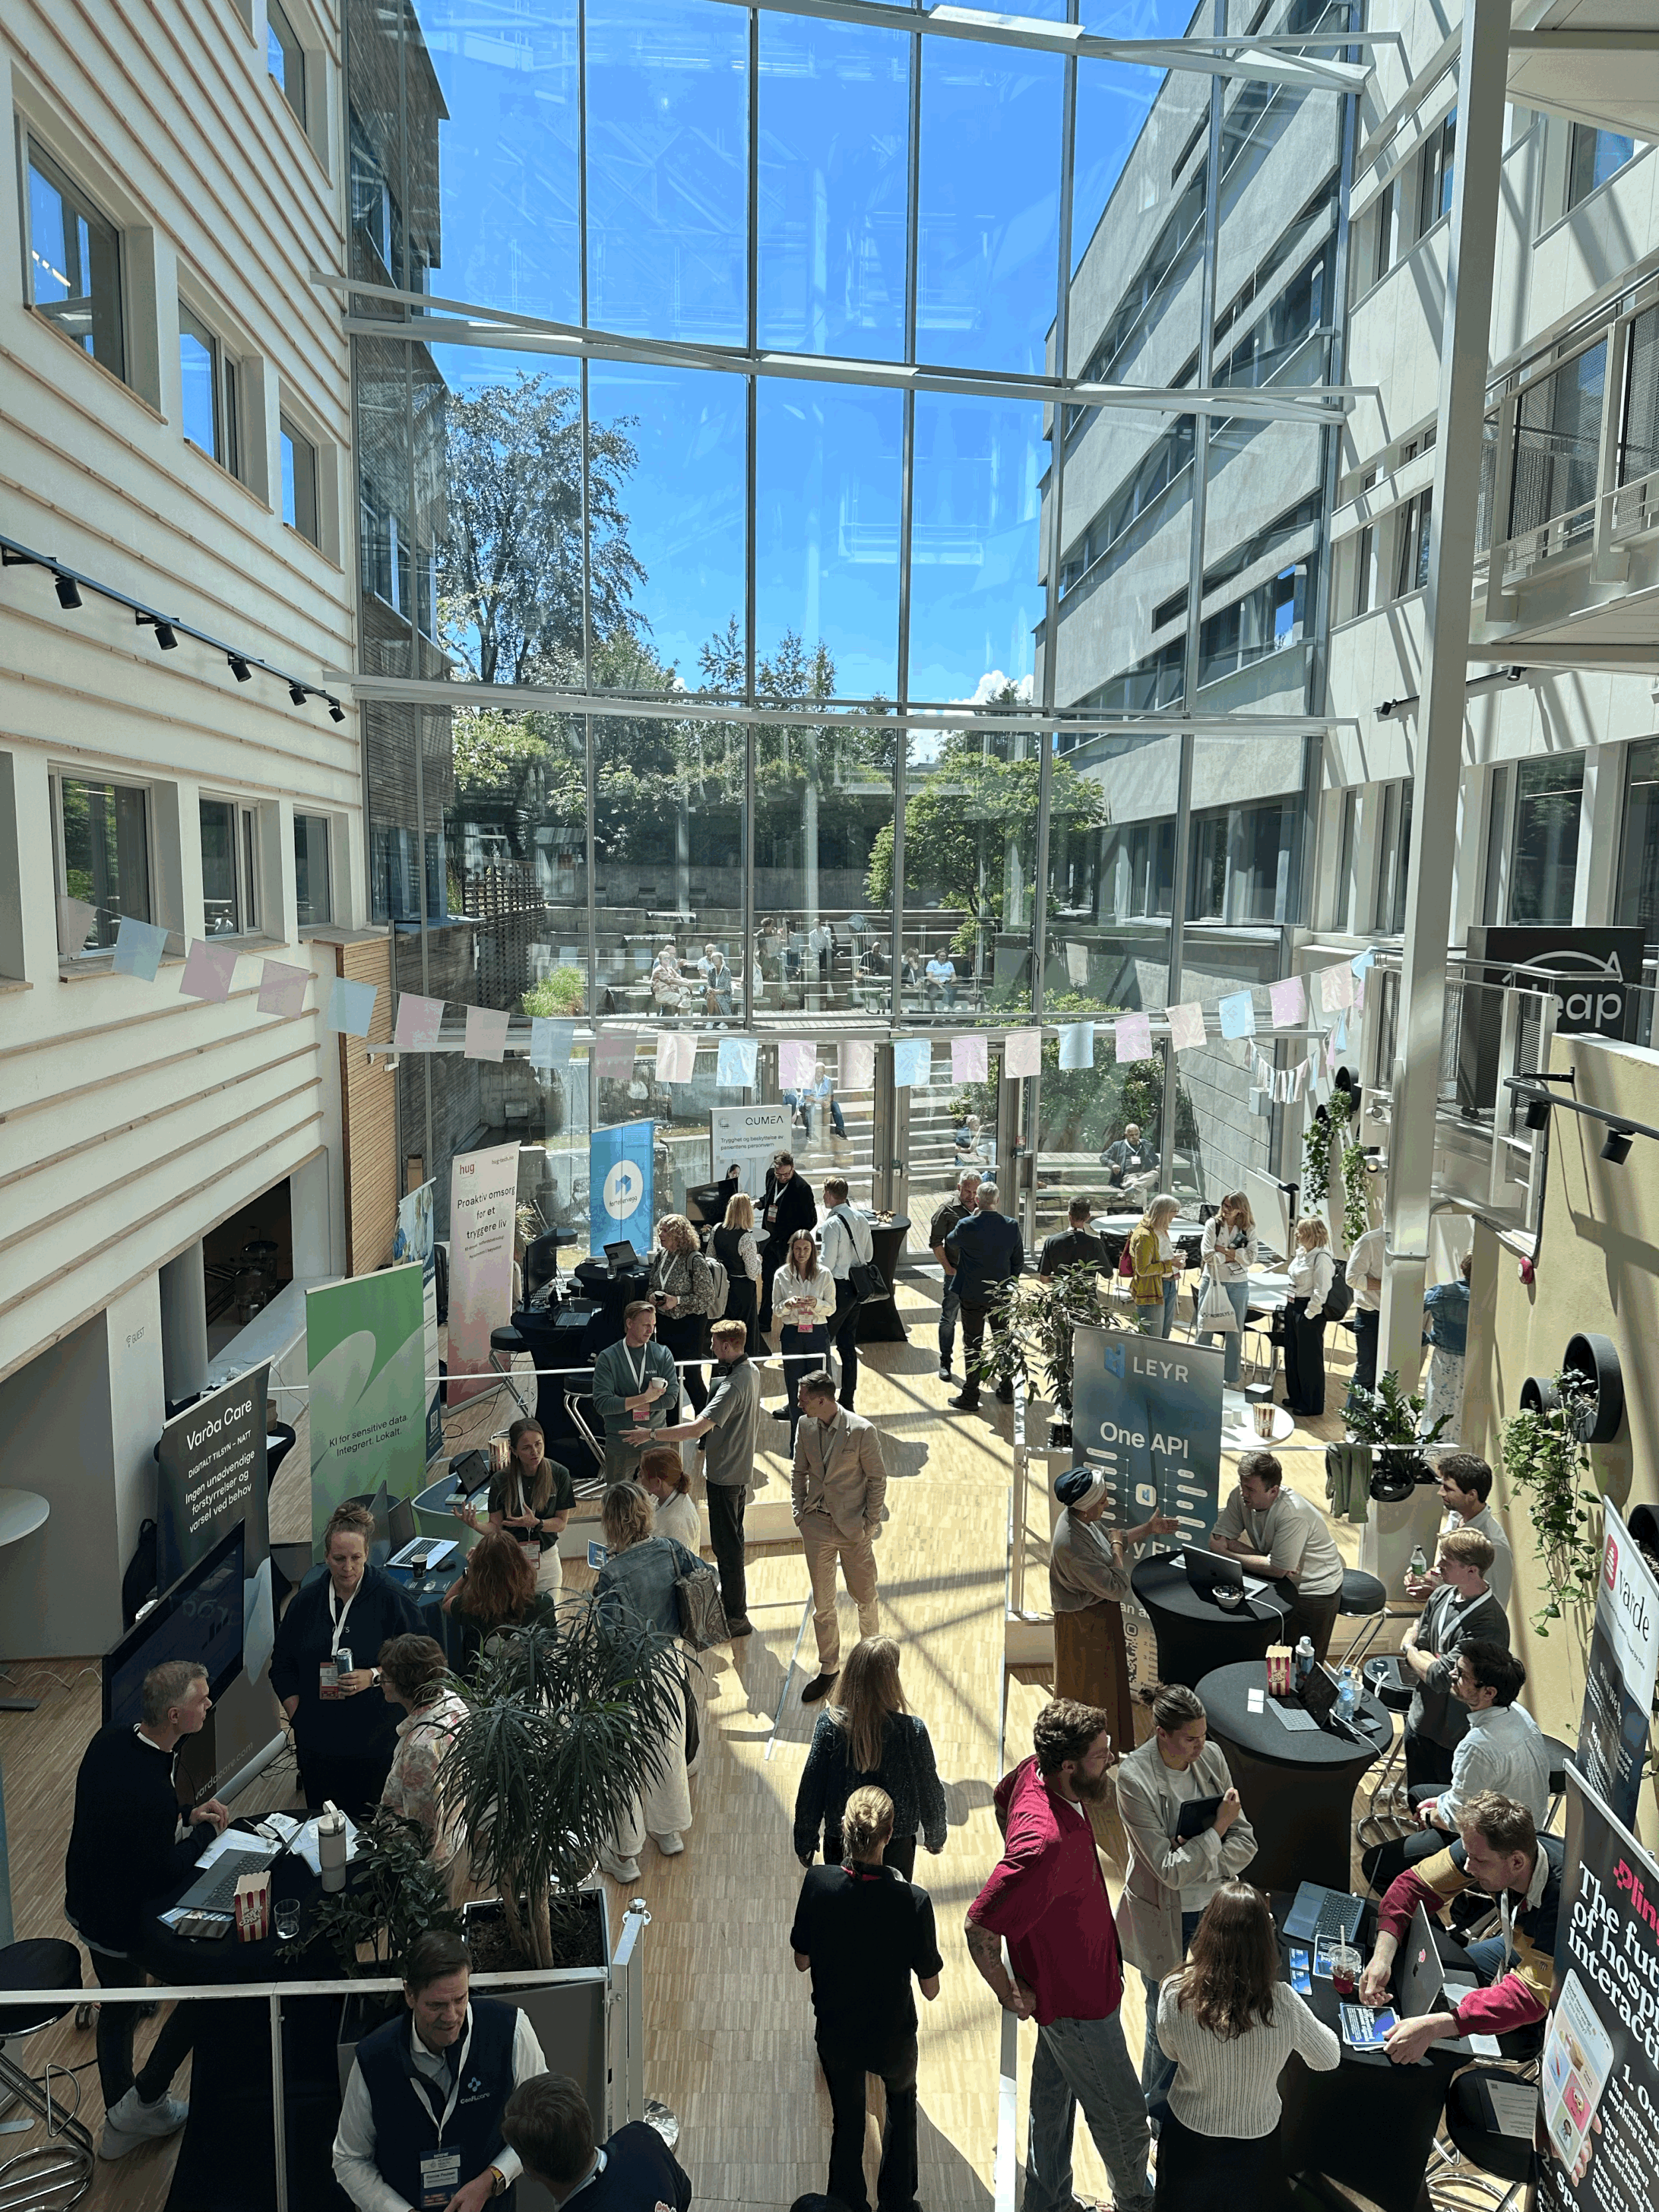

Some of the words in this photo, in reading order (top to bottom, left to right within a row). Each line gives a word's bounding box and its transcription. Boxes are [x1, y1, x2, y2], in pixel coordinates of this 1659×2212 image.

[745, 1116, 784, 1126] QUMEA
[459, 1163, 474, 1175] hug
[457, 1193, 487, 1209] Proaktiv
[488, 1186, 516, 1200] omsorg
[476, 1209, 486, 1220] for
[487, 1207, 496, 1216] et
[467, 1223, 496, 1240] tryggere
[498, 1218, 507, 1228] liv
[132, 1327, 144, 1343] GUEST
[1133, 1357, 1189, 1383] LEYR
[224, 1400, 252, 1426] Care
[329, 1438, 337, 1447] KI
[339, 1434, 350, 1444] for
[352, 1422, 387, 1439] sensitive
[336, 1438, 374, 1457] Integrert.
[376, 1428, 402, 1443] Lokalt.
[1100, 1422, 1145, 1448] One
[1150, 1433, 1189, 1459] API
[188, 1455, 212, 1479] DIGITALT
[212, 1442, 231, 1461] TILSYN
[237, 1430, 252, 1445] NATT
[185, 1484, 205, 1505] Ingen
[206, 1449, 255, 1488] unødvendige
[192, 1477, 237, 1516] forstyrrelser
[238, 1470, 249, 1481] og
[189, 1510, 211, 1533] varsel
[213, 1498, 228, 1516] ved
[228, 1483, 252, 1504] behov
[1620, 1569, 1649, 1642] varde
[195, 1742, 253, 1801] vardacare.com
[1579, 1860, 1620, 1934] The
[1613, 1858, 1659, 1946] Plin
[1574, 1901, 1599, 1941] of
[1623, 2063, 1634, 2091] 1.
[1612, 2076, 1623, 2101] The
[1624, 2099, 1648, 2139] patient
[1603, 2105, 1619, 2139] Want
[1619, 2138, 1625, 2149] a
[1626, 2148, 1650, 2188] coffee?
[1609, 2090, 1637, 2140] anything
[1638, 2134, 1654, 2166] from
[1542, 2147, 1553, 2177] 2.
[1605, 2127, 1614, 2144] Or
[1614, 2144, 1642, 2191] perhaps
